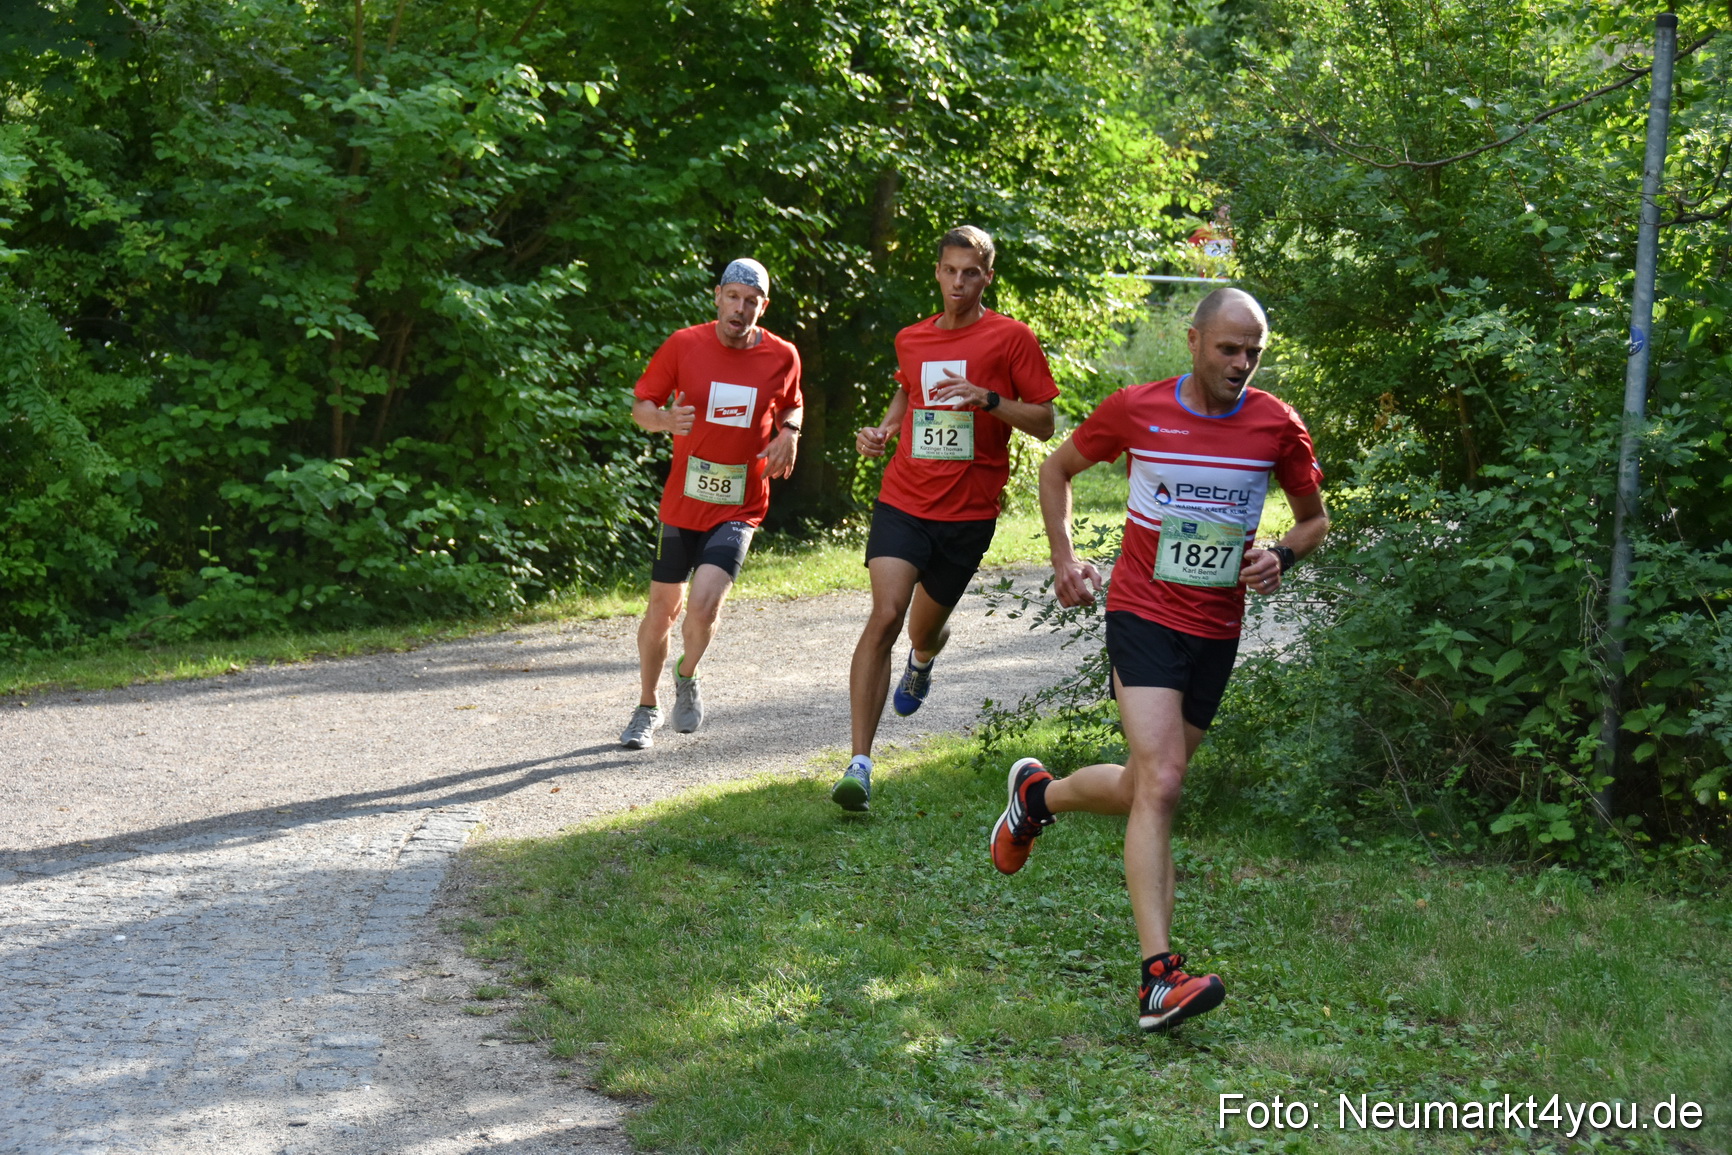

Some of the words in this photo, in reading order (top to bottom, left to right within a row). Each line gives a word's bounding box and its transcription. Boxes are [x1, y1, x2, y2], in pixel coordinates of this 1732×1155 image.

[924, 428, 958, 446] 512
[697, 475, 731, 494] 558
[1176, 483, 1251, 506] Petry
[1170, 541, 1235, 569] 1827
[1198, 568, 1218, 576] Bernd
